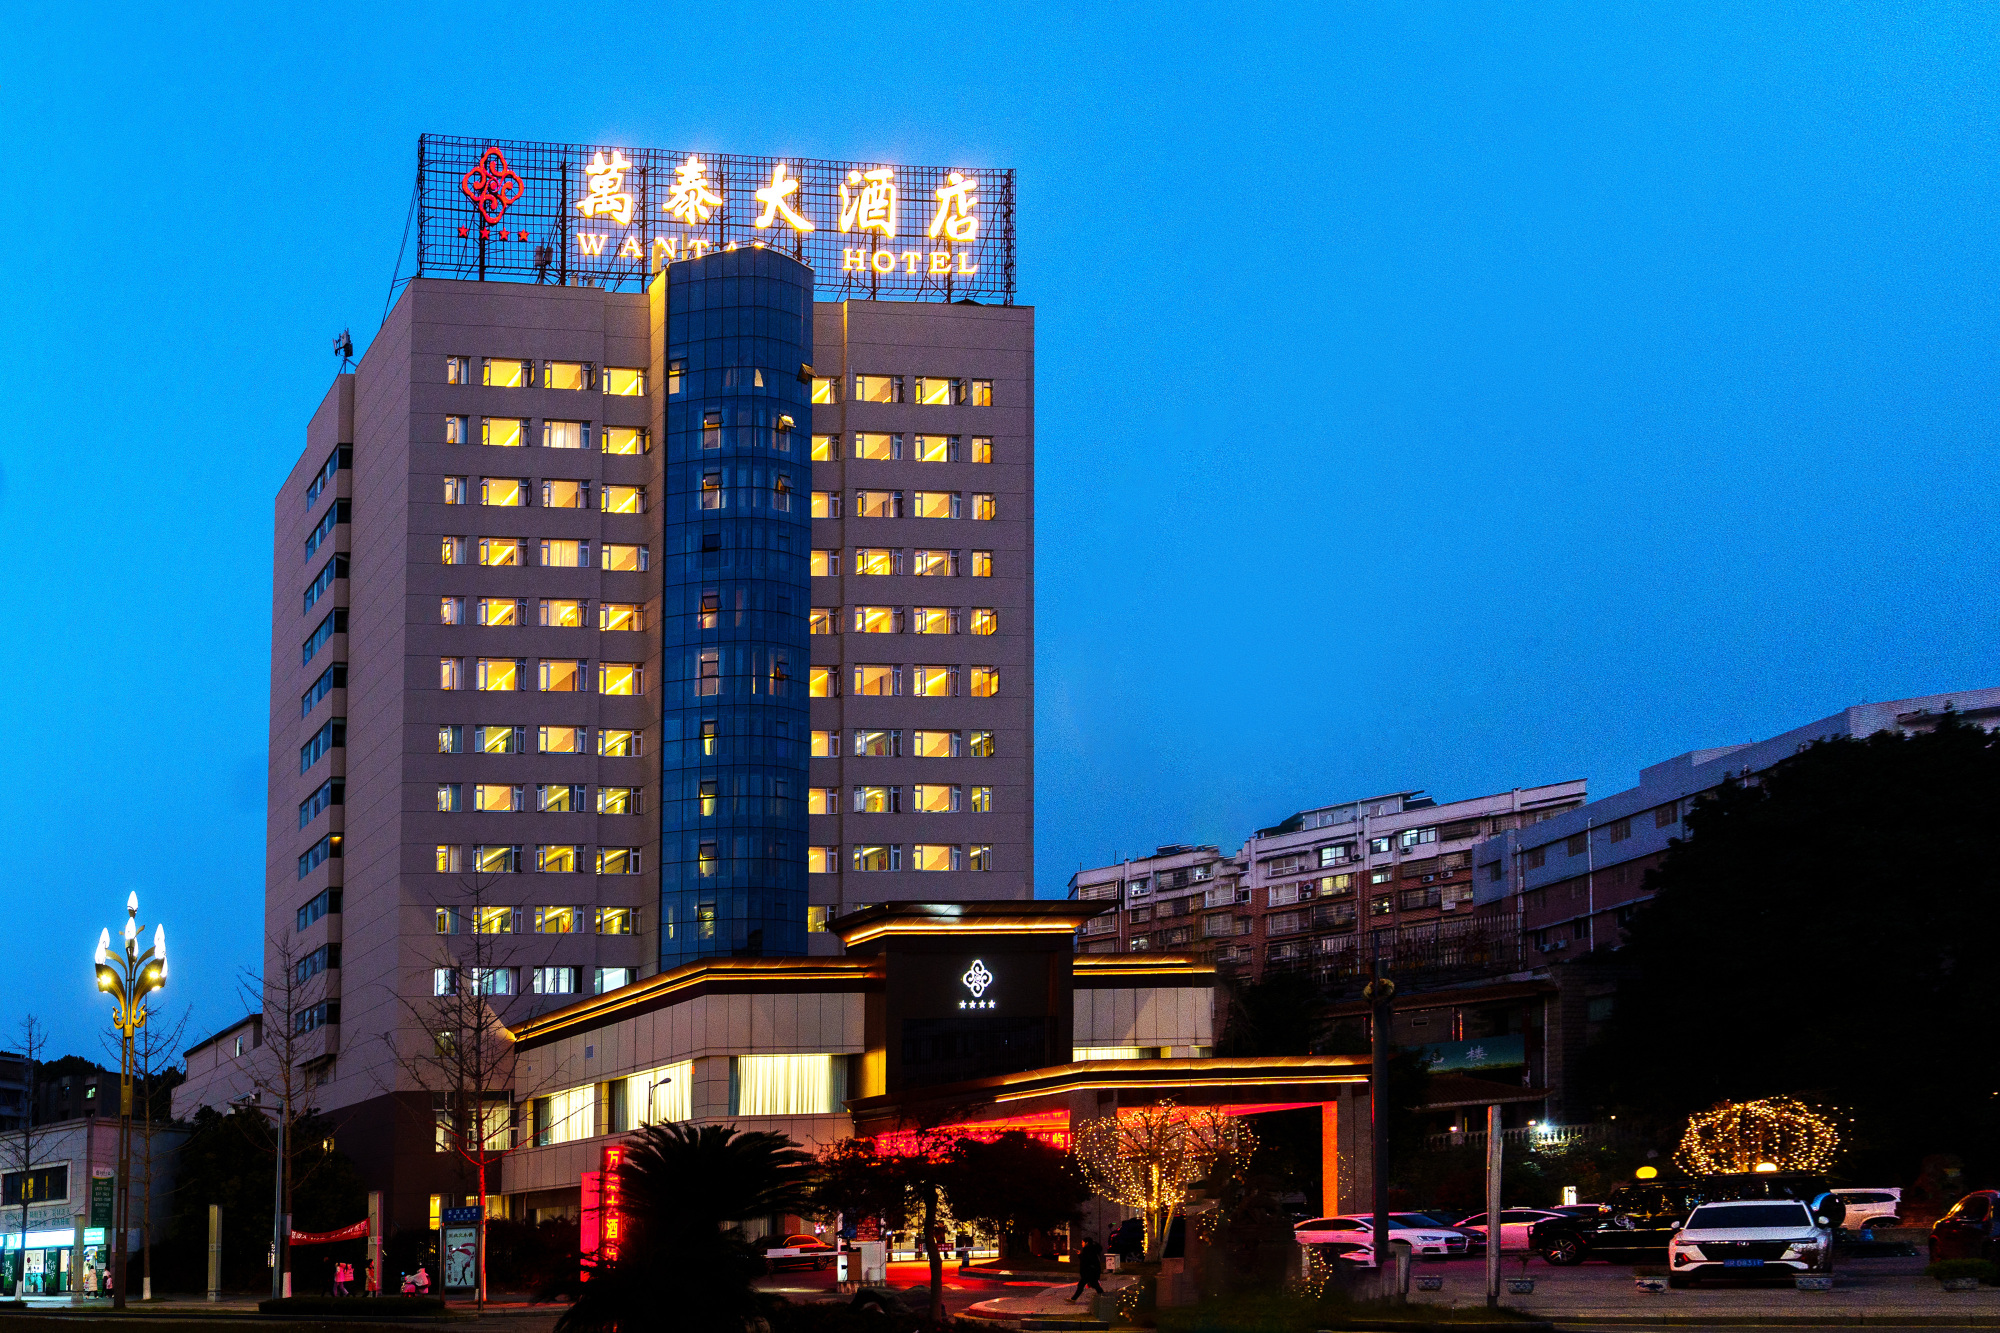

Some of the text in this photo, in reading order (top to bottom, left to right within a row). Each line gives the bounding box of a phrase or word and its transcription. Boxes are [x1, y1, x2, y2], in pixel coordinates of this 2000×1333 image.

[576, 151, 980, 241] 萬泰大酒店
[576, 232, 978, 274] WANT HOTEL
